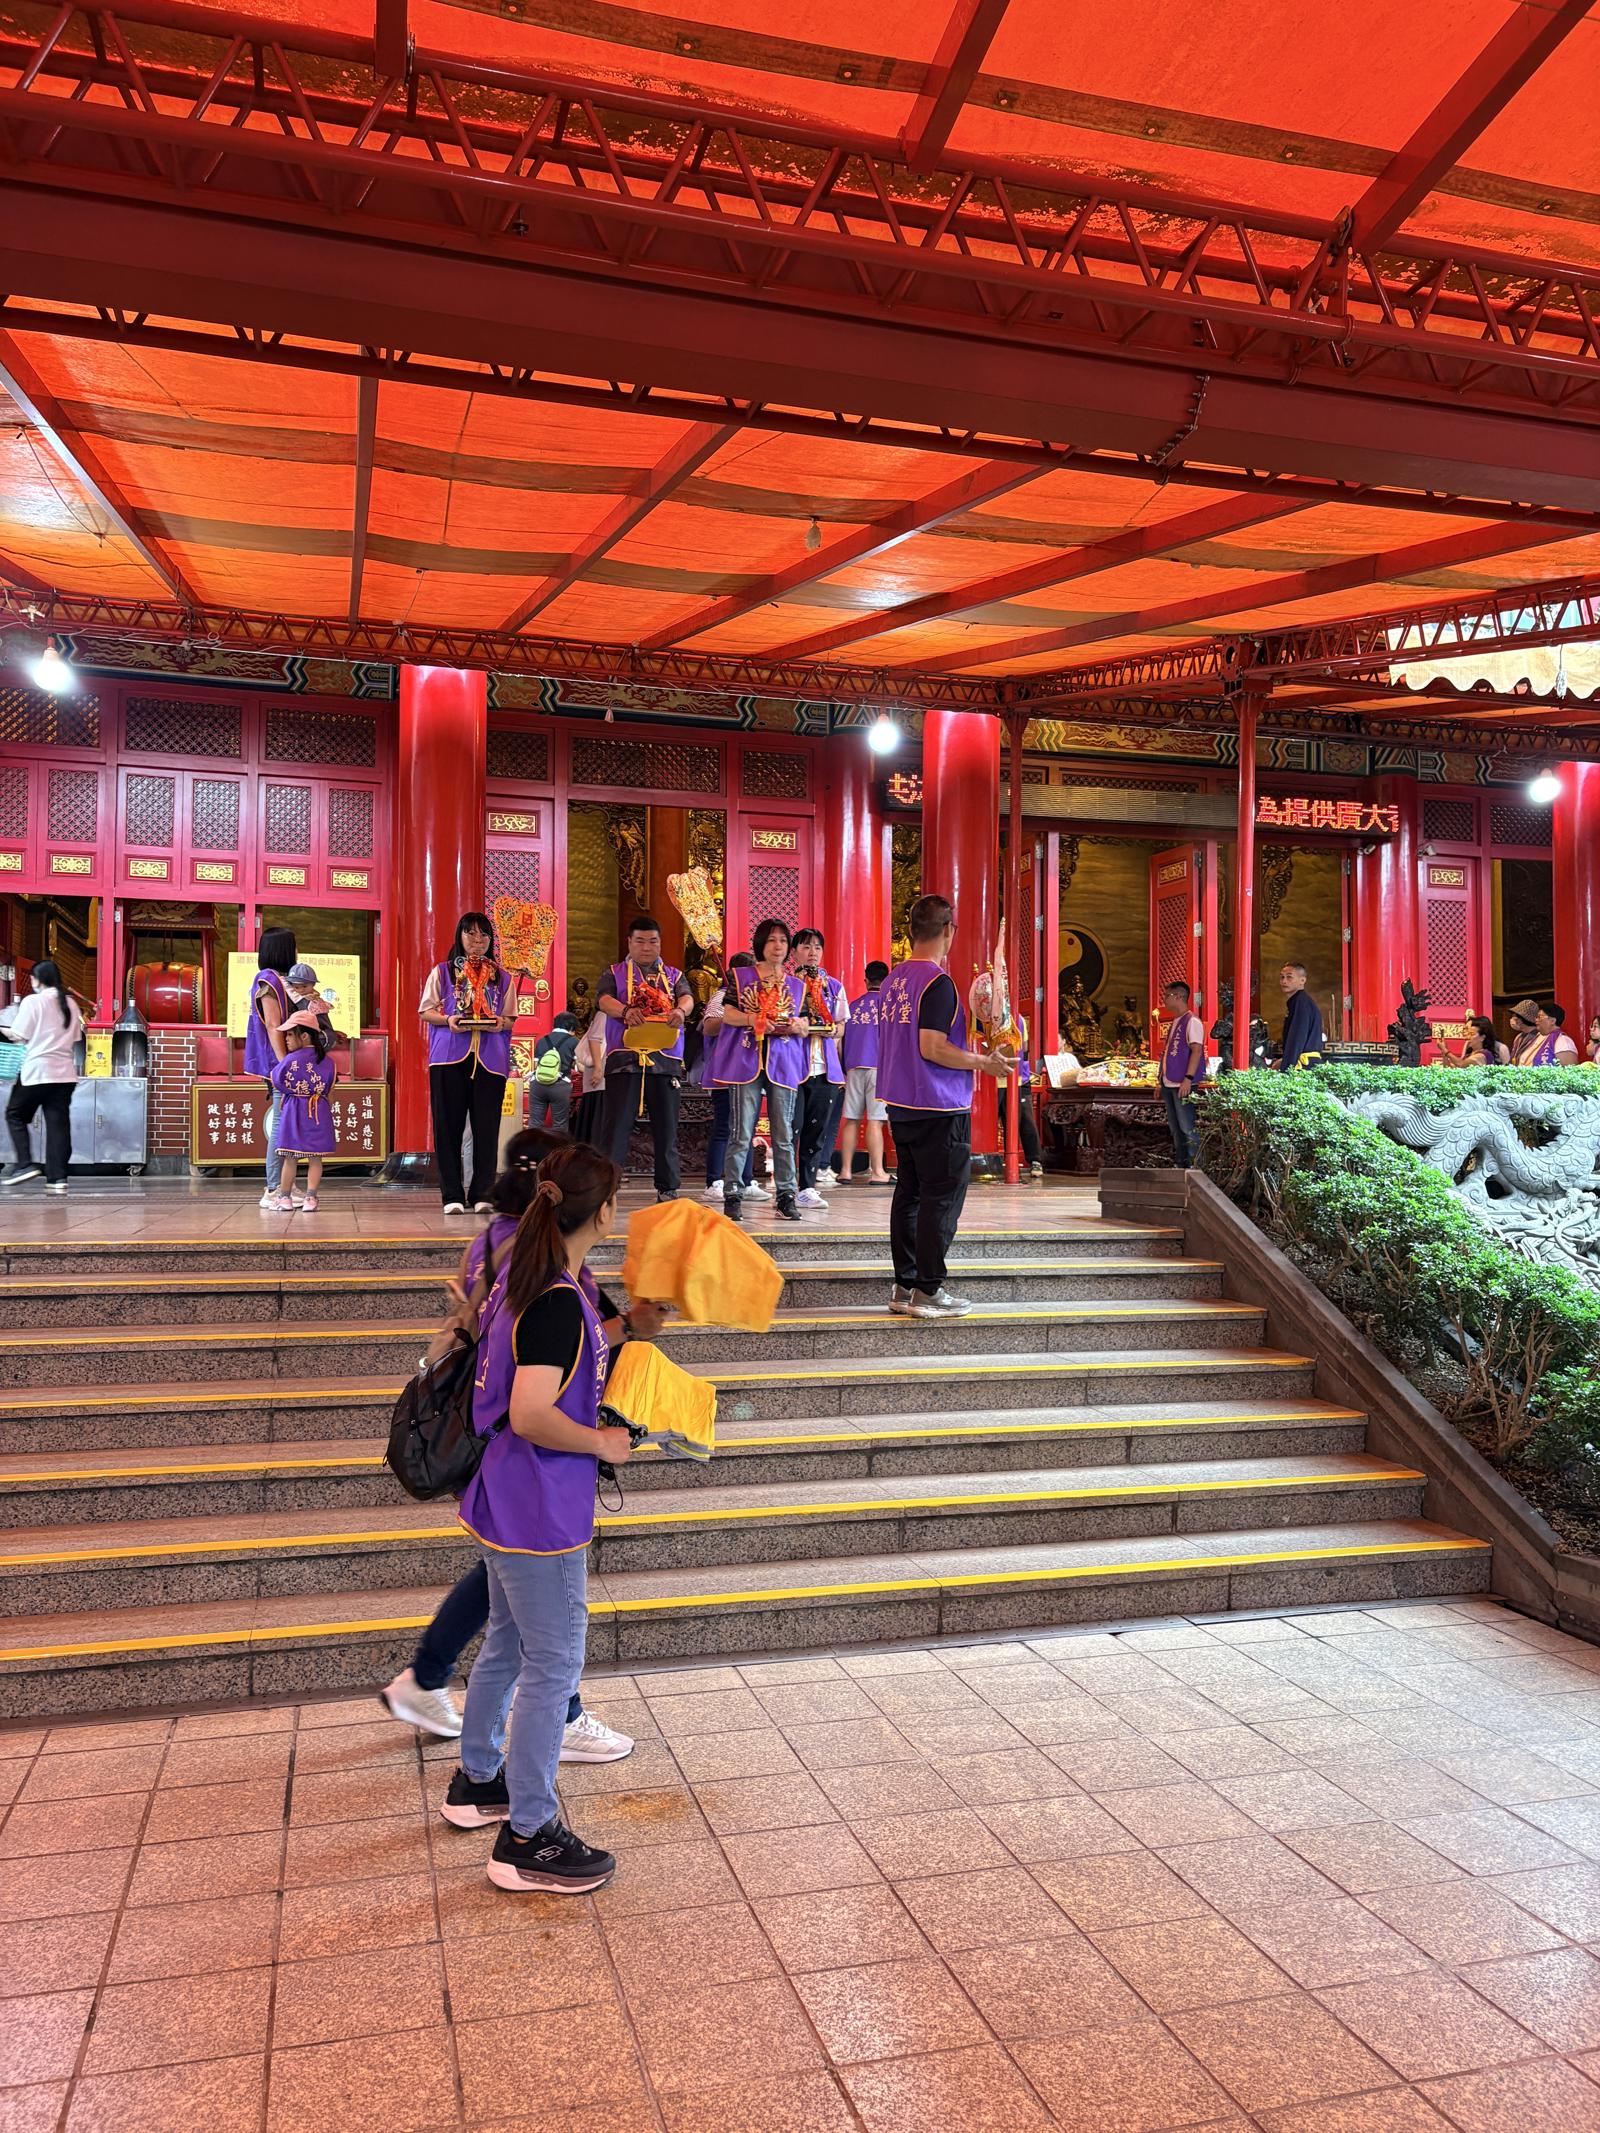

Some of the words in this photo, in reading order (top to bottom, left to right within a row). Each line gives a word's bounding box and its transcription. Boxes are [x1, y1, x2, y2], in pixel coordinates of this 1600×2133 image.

[290, 1060, 315, 1073] 屏東
[207, 1103, 221, 1145] 做好事
[241, 1102, 255, 1145] 學好樣
[345, 1102, 359, 1142] 存好心
[361, 1094, 375, 1151] 道祖慈悲
